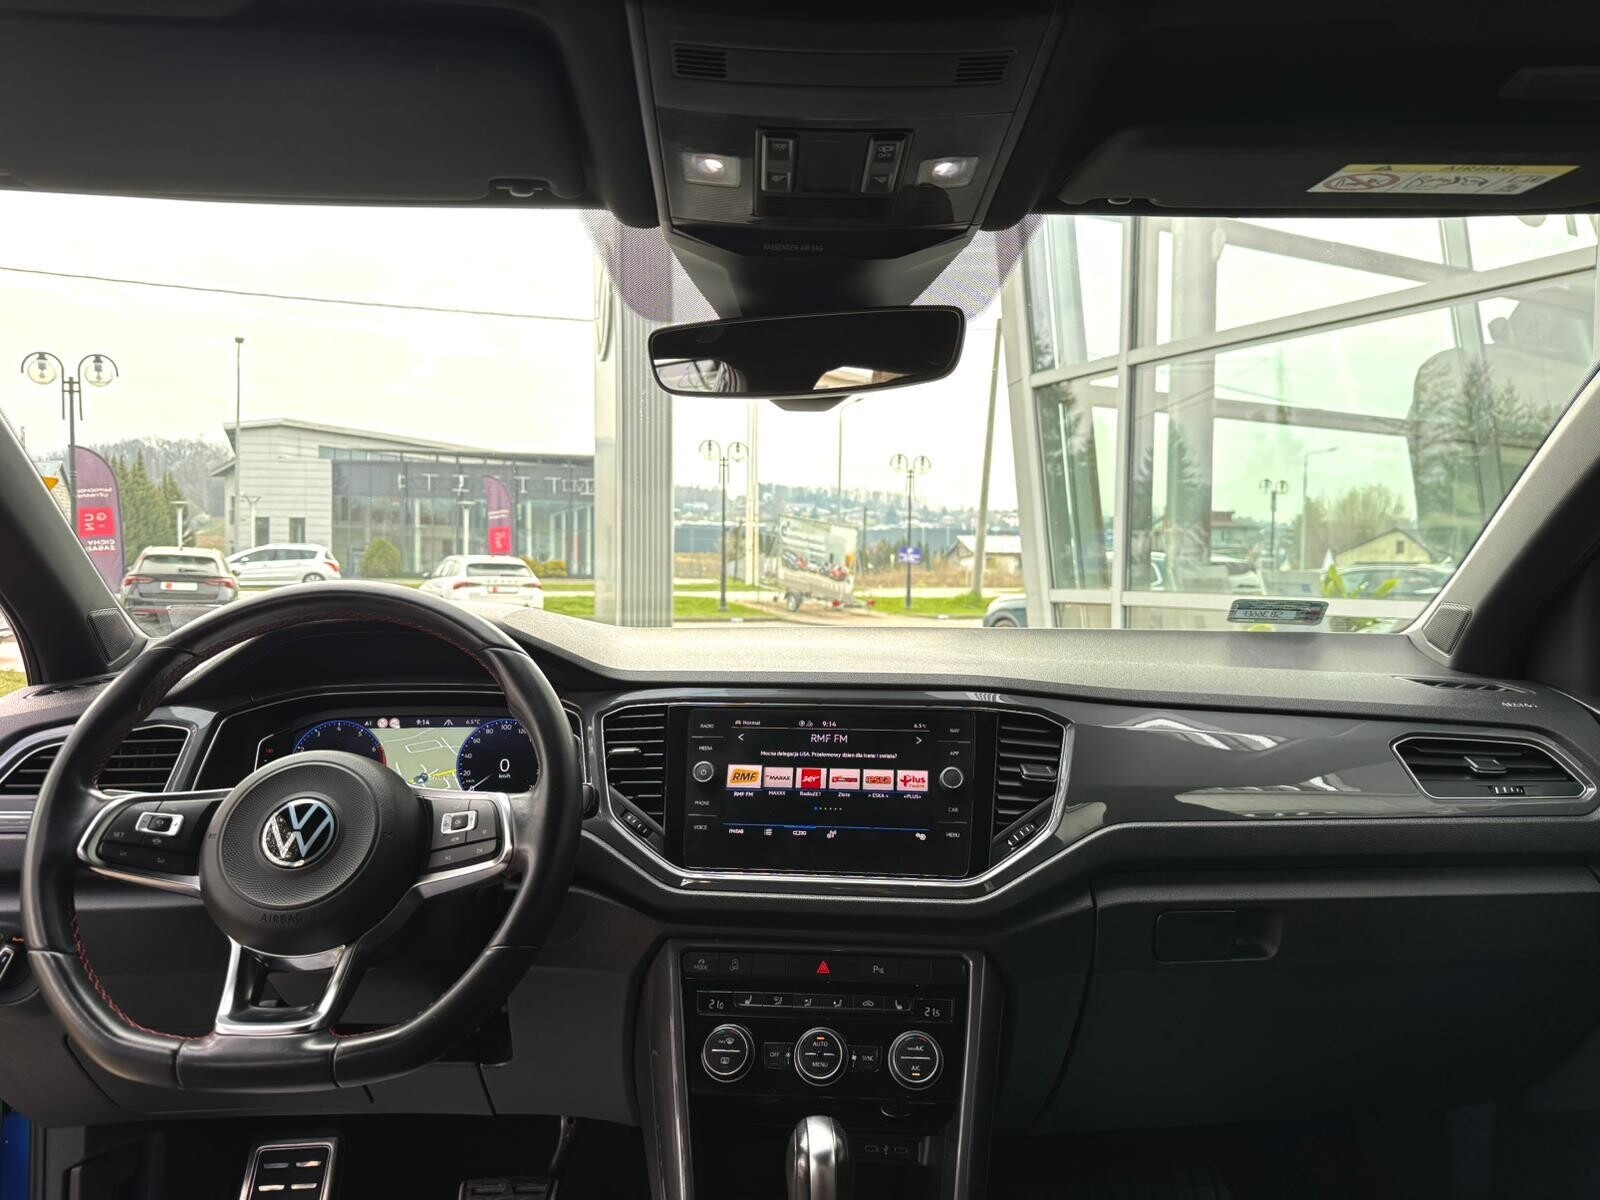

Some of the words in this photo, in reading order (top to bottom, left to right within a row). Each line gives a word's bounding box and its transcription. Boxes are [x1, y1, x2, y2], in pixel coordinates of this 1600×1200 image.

[811, 733, 832, 743] RMF
[833, 734, 848, 743] FM
[500, 758, 510, 772] 0
[732, 772, 757, 781] RMF
[260, 913, 304, 924] AIRBAG
